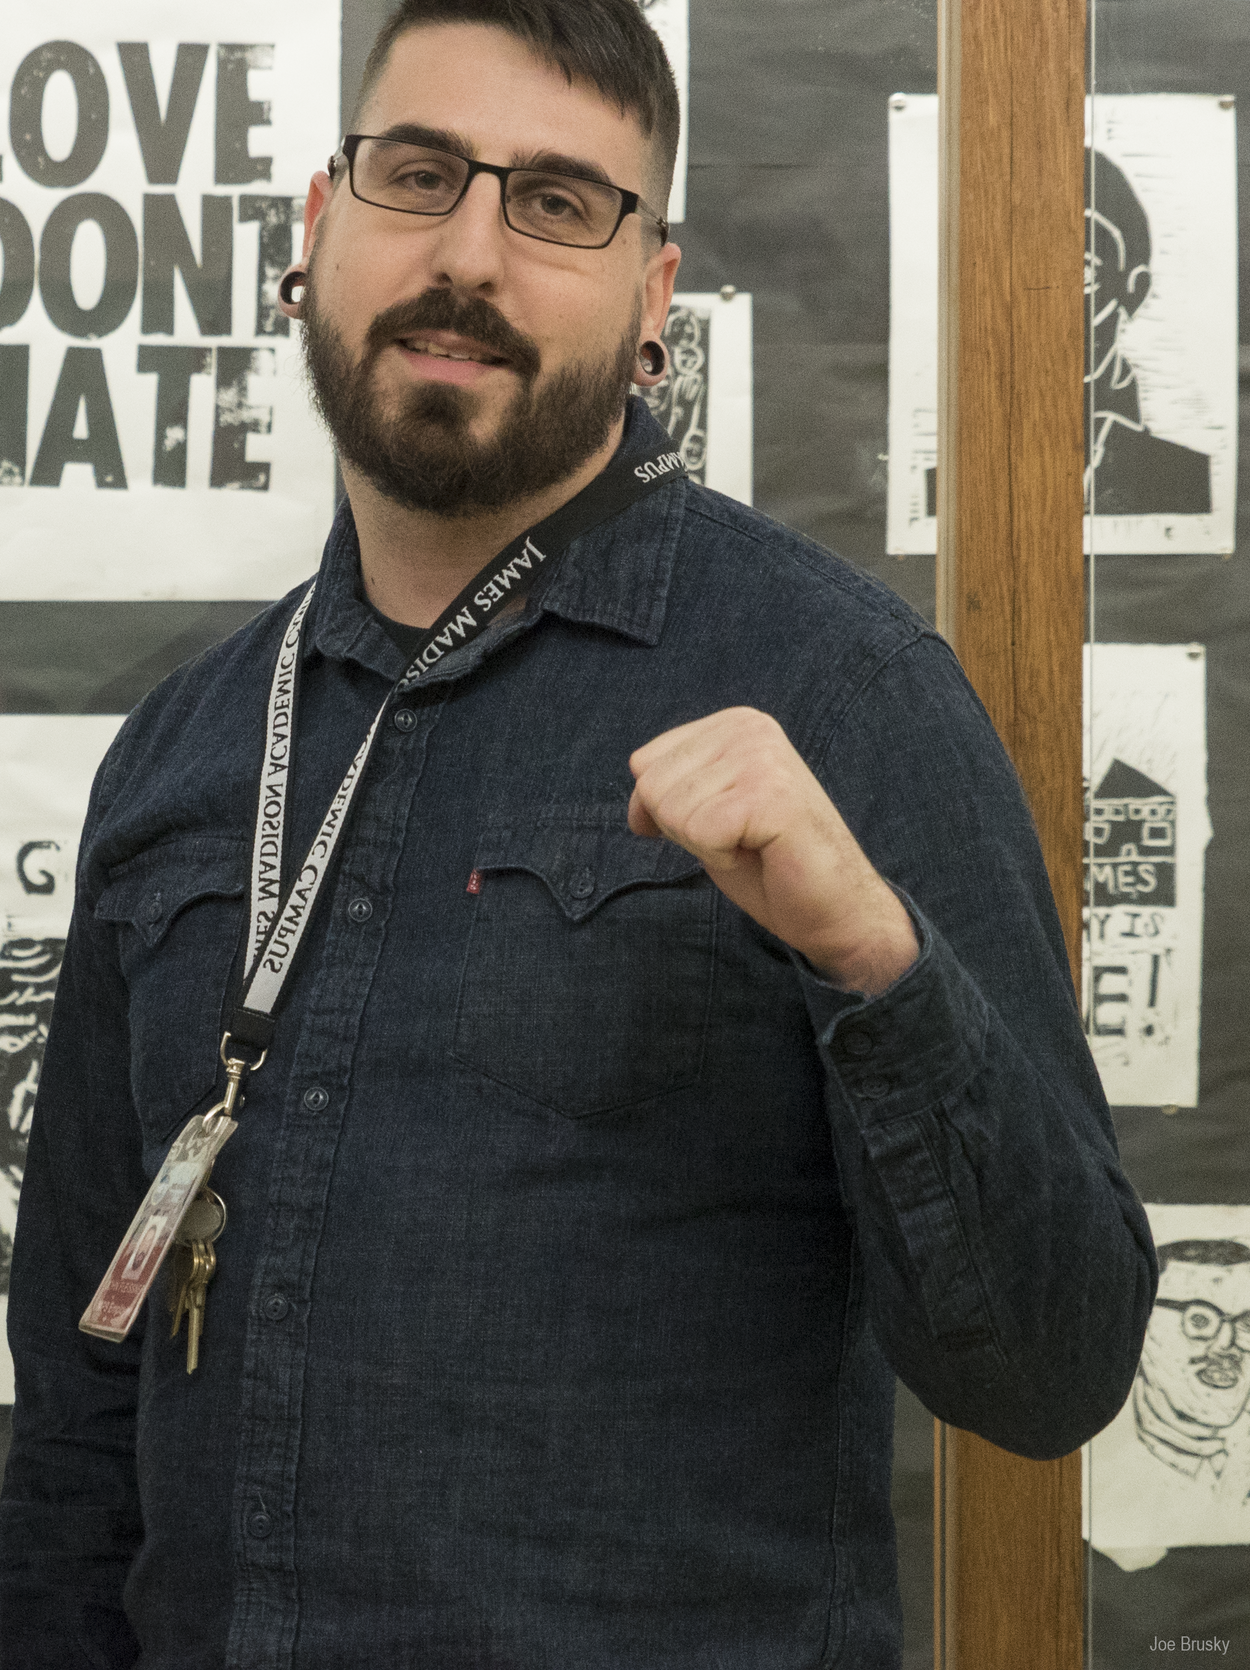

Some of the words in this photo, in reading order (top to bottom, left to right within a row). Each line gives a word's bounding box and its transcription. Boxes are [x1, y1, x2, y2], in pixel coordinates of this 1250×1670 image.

[634, 451, 687, 483] AMPUS
[474, 536, 547, 612] JAMES
[1084, 863, 1158, 893] MES
